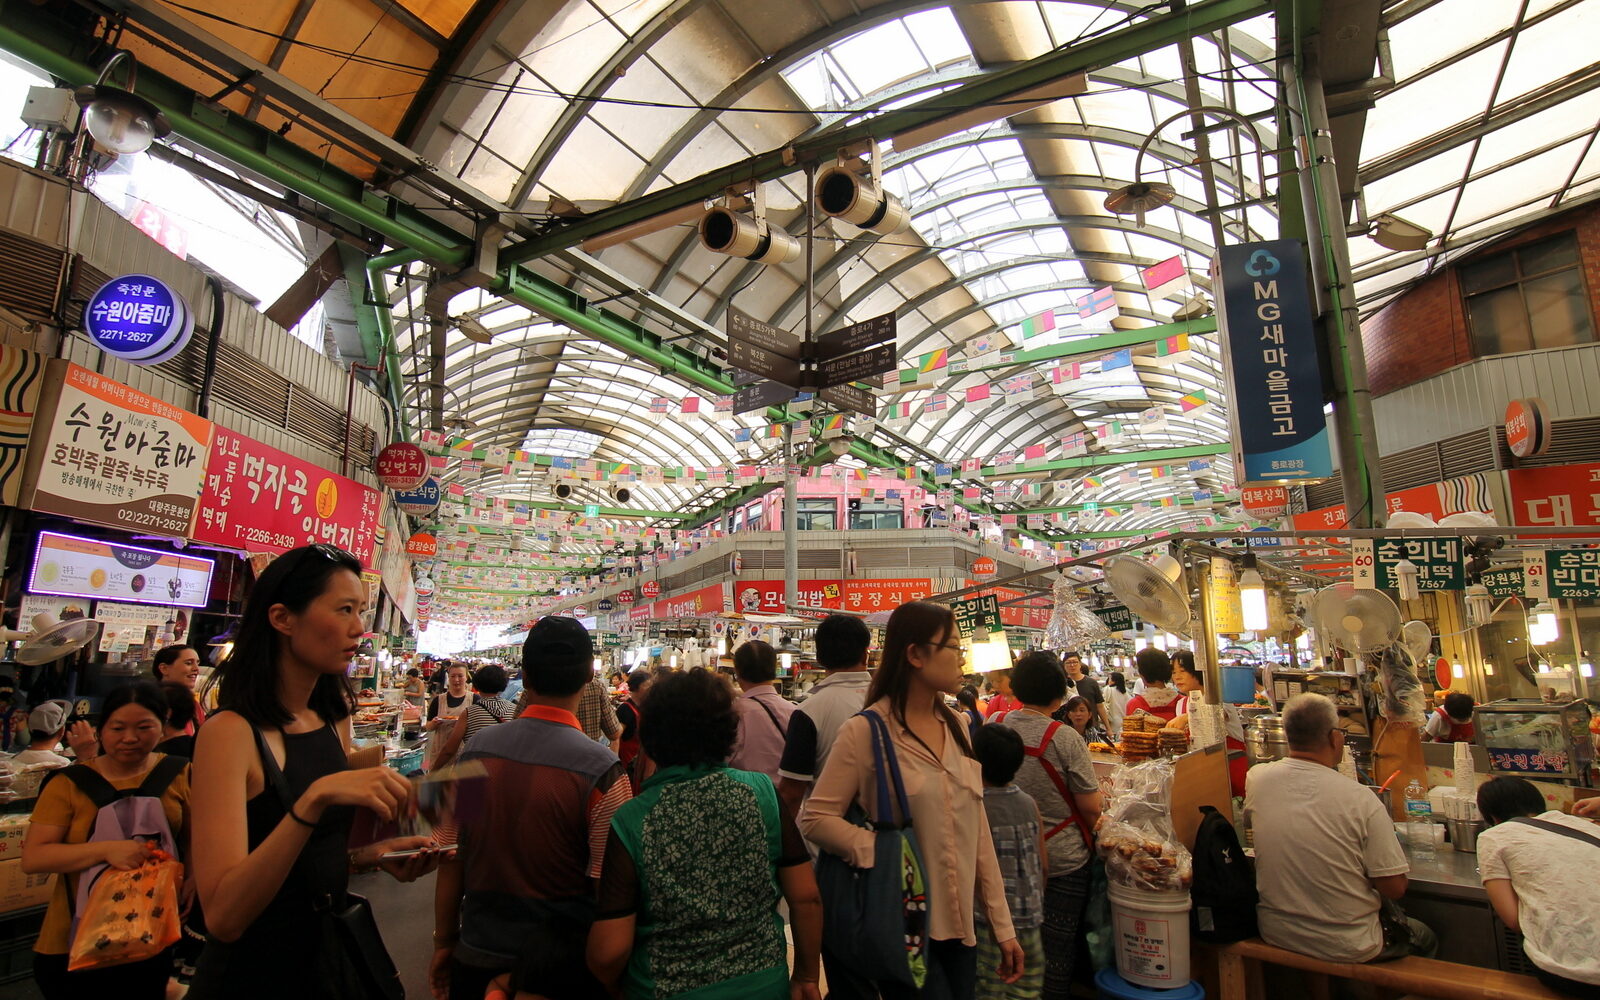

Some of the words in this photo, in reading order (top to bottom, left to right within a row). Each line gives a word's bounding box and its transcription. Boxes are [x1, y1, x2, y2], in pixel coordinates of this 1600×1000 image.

[117, 283, 156, 298] 죽전문
[92, 300, 170, 326] 수원아줌마
[99, 329, 153, 343] 2271-2627
[1254, 280, 1296, 436] MG새마을금고
[101, 381, 125, 398] 어머니의
[127, 392, 150, 408] 정성으로
[65, 402, 196, 468] 수원아줌마
[379, 462, 422, 475] 일번지
[1271, 459, 1304, 470] 종로광장
[61, 471, 102, 492] 방송매체에서
[242, 452, 309, 515] 먹자골
[1243, 487, 1285, 503] 대복상회
[148, 500, 190, 519] 대량주문환영
[117, 509, 188, 532] 02)2271-2627
[408, 541, 437, 553] 광장순대
[1378, 540, 1458, 563] 순희네
[1355, 555, 1373, 566] 60
[1359, 569, 1368, 578] 호
[1528, 565, 1543, 576] 61
[1388, 580, 1446, 588] 22-7567
[1531, 579, 1540, 587] 호
[953, 596, 996, 620] 순희네
